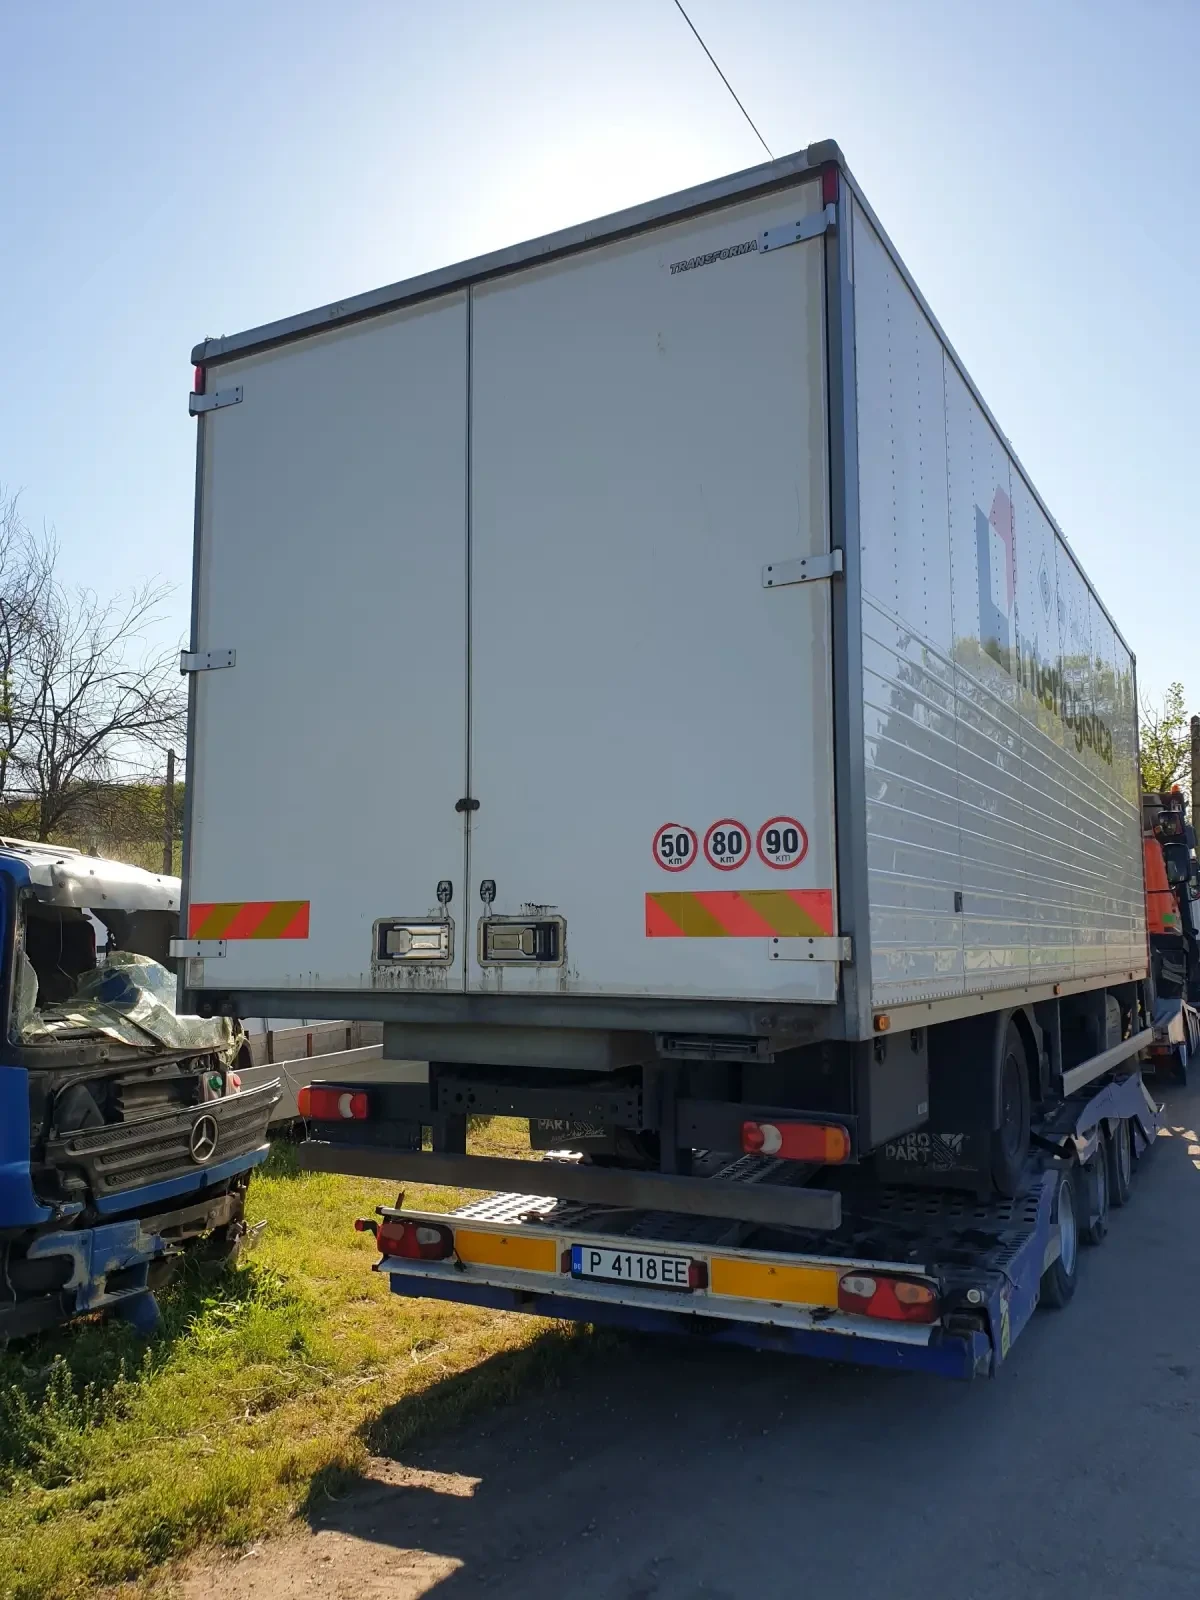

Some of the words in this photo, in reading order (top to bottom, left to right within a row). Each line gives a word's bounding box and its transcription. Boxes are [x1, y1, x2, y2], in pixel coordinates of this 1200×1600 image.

[670, 239, 758, 275] TRANSFORMA
[661, 833, 690, 858] 50
[712, 830, 742, 856] 80
[765, 828, 799, 855] 90
[885, 1144, 931, 1162] PART
[590, 1251, 602, 1273] P
